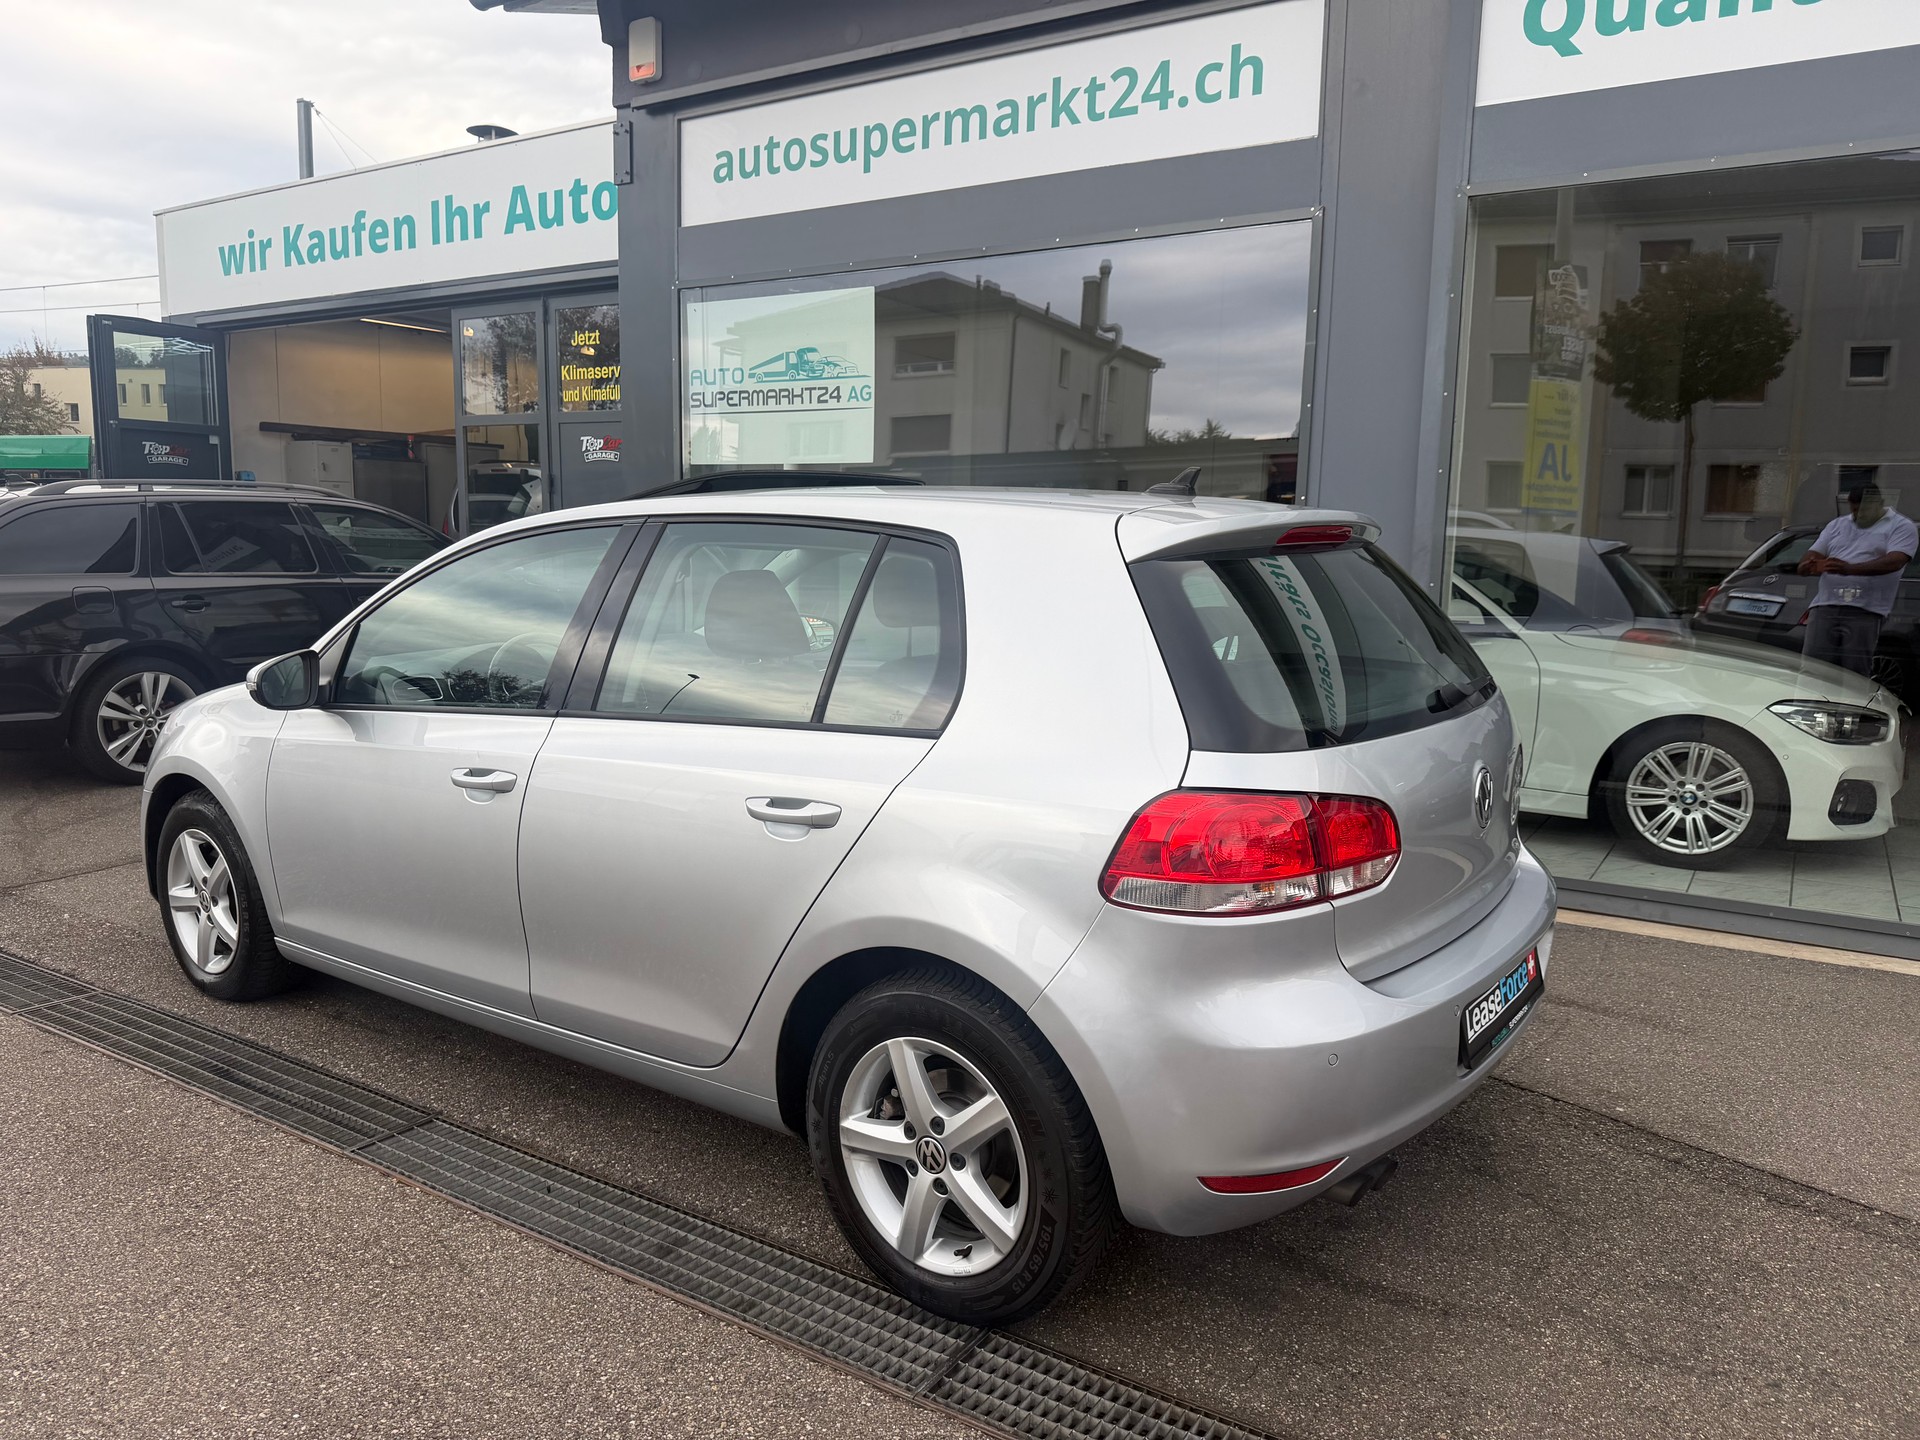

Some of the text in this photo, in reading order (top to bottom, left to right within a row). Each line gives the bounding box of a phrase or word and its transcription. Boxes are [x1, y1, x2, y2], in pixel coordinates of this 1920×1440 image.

[714, 44, 1264, 183] autosupermarkt24.ch
[218, 178, 620, 276] wir Kaufen Ihr Auto
[571, 330, 600, 346] Jetzt
[561, 365, 621, 380] Klimaserv
[690, 367, 744, 386] AUTO
[563, 385, 621, 402] und Klimafüll
[690, 384, 872, 408] SUPERMARKT24 AG
[588, 452, 615, 460] GARAGE
[1466, 962, 1528, 1041] LeaseForce
[1012, 1225, 1052, 1294] 195/65 R 15
